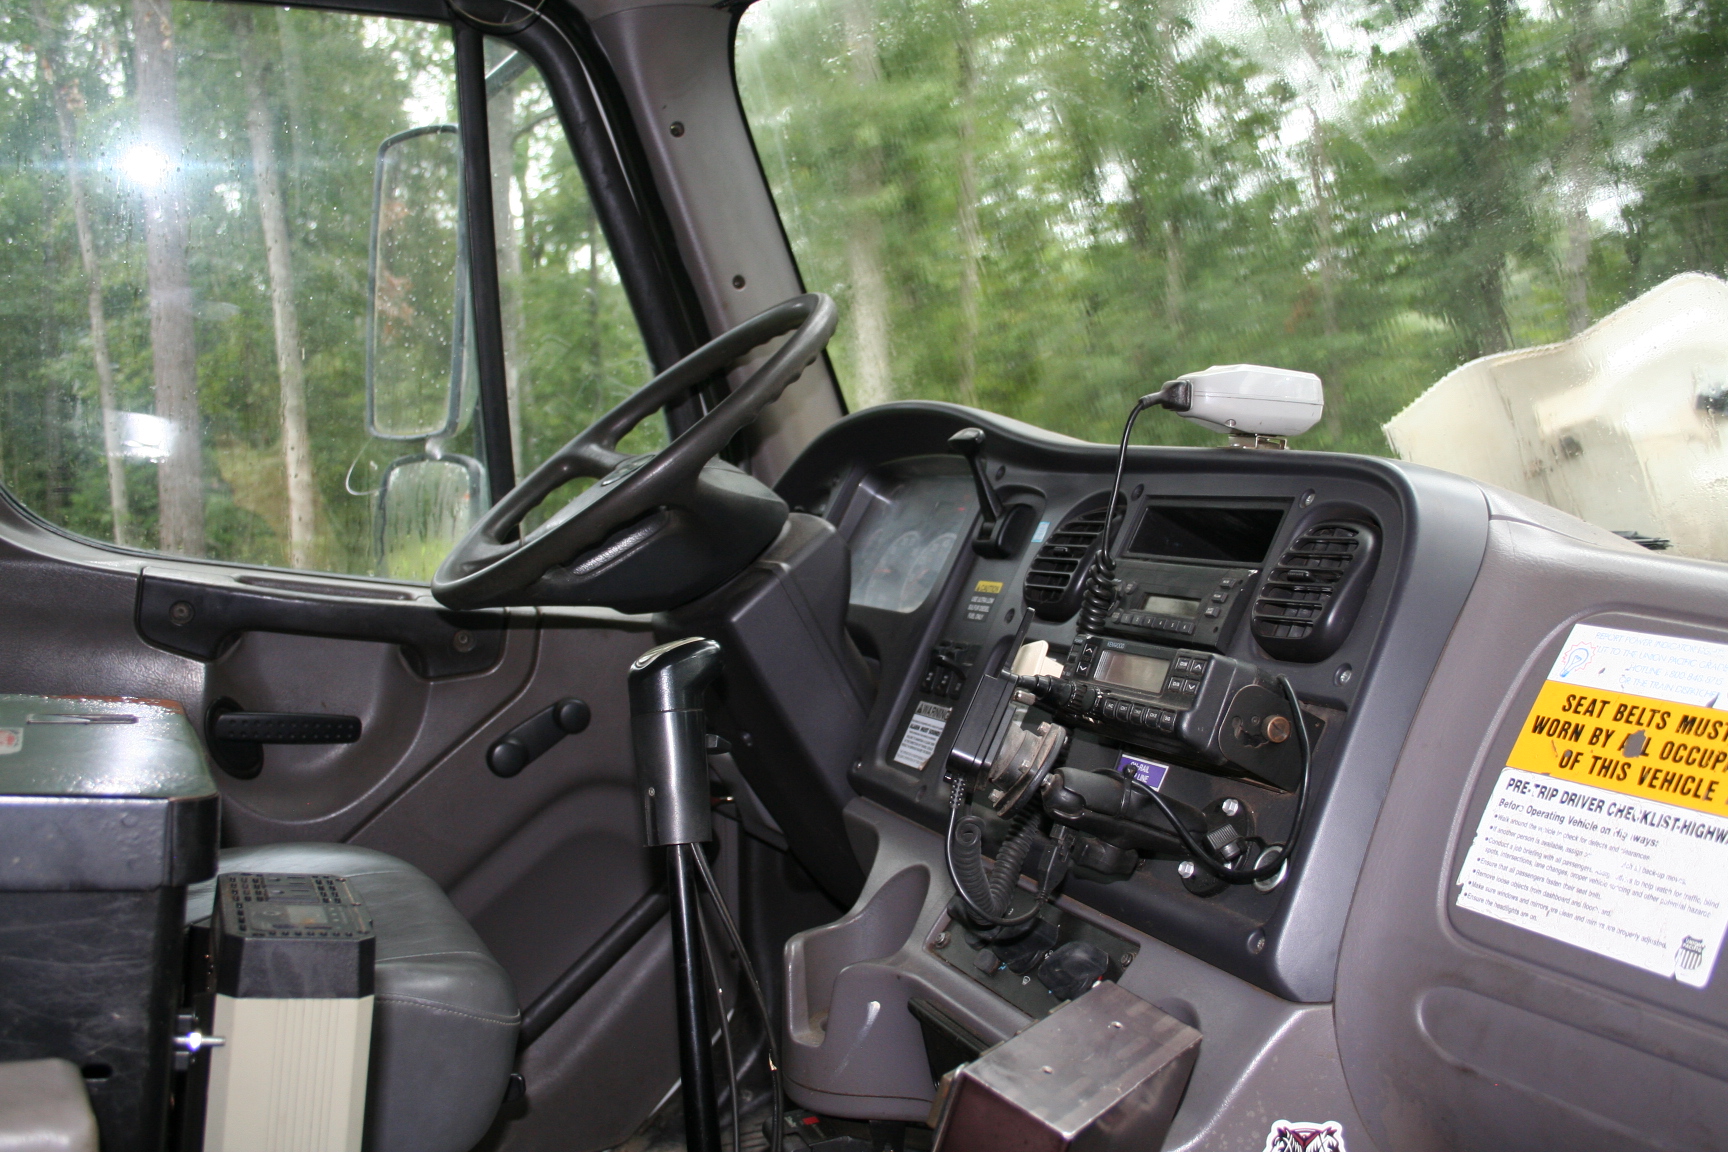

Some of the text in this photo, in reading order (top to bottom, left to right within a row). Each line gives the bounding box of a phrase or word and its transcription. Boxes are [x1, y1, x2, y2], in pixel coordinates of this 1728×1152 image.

[1107, 641, 1125, 649] KENWOOD
[1610, 647, 1621, 655] TO
[1623, 649, 1638, 657] THE
[1638, 652, 1667, 662] UNION
[1668, 656, 1697, 666] PACIFIC
[1629, 664, 1662, 675] HOTLINE
[1633, 678, 1648, 686] THE
[1649, 681, 1674, 691] TRAIN
[1674, 685, 1720, 699] DISPATCHE
[1561, 694, 1610, 718] SEAT
[1612, 703, 1671, 730] BELTS
[1531, 715, 1585, 742] WORN
[1587, 727, 1615, 748] BY
[1617, 733, 1654, 756] AL
[1136, 773, 1149, 783] LINE
[1558, 749, 1719, 800] OF THIS VEHICLE
[1505, 778, 1728, 844] PRE-TRIP DRIVER CHECKLIST-HIGHW
[1525, 805, 1565, 824] Operating
[1567, 816, 1599, 831] Vehicle
[1612, 828, 1659, 848] Higways:
[1510, 818, 1528, 827] around
[1538, 826, 1556, 835] vhicle
[1562, 832, 1579, 841] check
[1587, 839, 1608, 849] defects
[1497, 827, 1516, 837] another
[1516, 834, 1534, 843] person
[1540, 840, 1564, 851] available,
[1564, 846, 1583, 856] assign
[1641, 867, 1665, 879] back-up
[1480, 858, 1498, 867] Ensure
[1515, 869, 1545, 883] passengers
[1545, 877, 1562, 886] fasten
[1562, 882, 1575, 890] their
[1576, 886, 1588, 894] seat
[1484, 848, 1499, 856] spots,
[1499, 852, 1533, 866] intersections,
[1569, 873, 1587, 882] proper
[1588, 877, 1608, 887] vehicle
[1643, 893, 1659, 902] other
[1487, 838, 1509, 848] Conduct
[1513, 845, 1522, 853] job
[1522, 847, 1542, 859] briefing
[1543, 853, 1554, 861] with
[1640, 881, 1654, 891] help
[1655, 885, 1673, 894] watch
[1703, 899, 1720, 908] blind
[1467, 893, 1484, 903] Ensure
[1493, 902, 1520, 915] headlights
[1475, 870, 1496, 880] Remove
[1496, 876, 1510, 884] loose
[1510, 880, 1529, 891] objects
[1529, 886, 1542, 894] from
[1542, 890, 1571, 903] dashboard
[1582, 903, 1612, 916] floorard.
[1471, 881, 1484, 890] Make
[1496, 889, 1519, 900] windows
[1519, 896, 1529, 904] and
[1530, 900, 1549, 910] mirrors
[1572, 914, 1585, 922] and
[1585, 918, 1605, 928] mirrrs
[1615, 928, 1640, 941] properly
[1640, 936, 1668, 950] adjusted.
